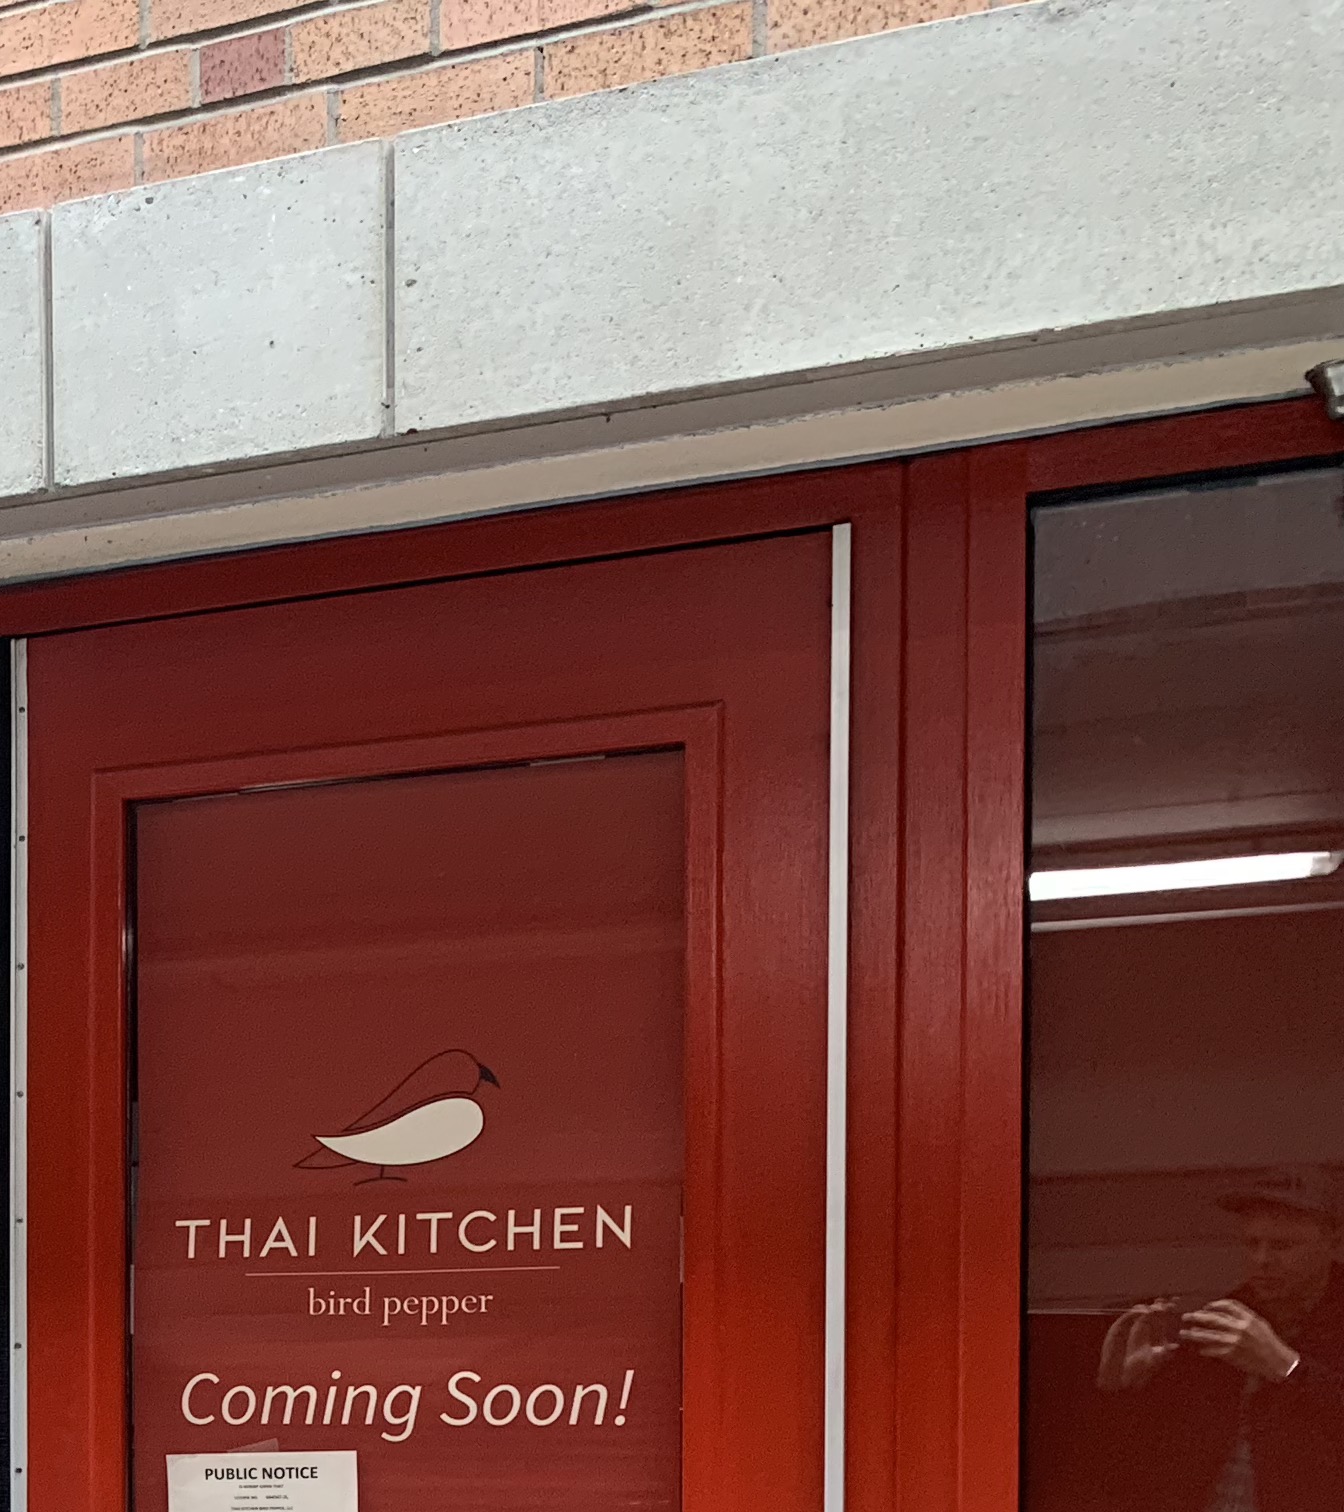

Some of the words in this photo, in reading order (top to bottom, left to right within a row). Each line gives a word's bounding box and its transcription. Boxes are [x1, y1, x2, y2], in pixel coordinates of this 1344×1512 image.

[176, 1216, 317, 1258] THAI
[353, 1204, 632, 1255] KITCHEN
[308, 1287, 371, 1316] bird
[382, 1290, 493, 1326] pepper
[181, 1369, 422, 1442] Coming
[440, 1369, 634, 1427] Soon!
[205, 1467, 258, 1480] PUBLIC
[262, 1466, 318, 1479] NOTICE
